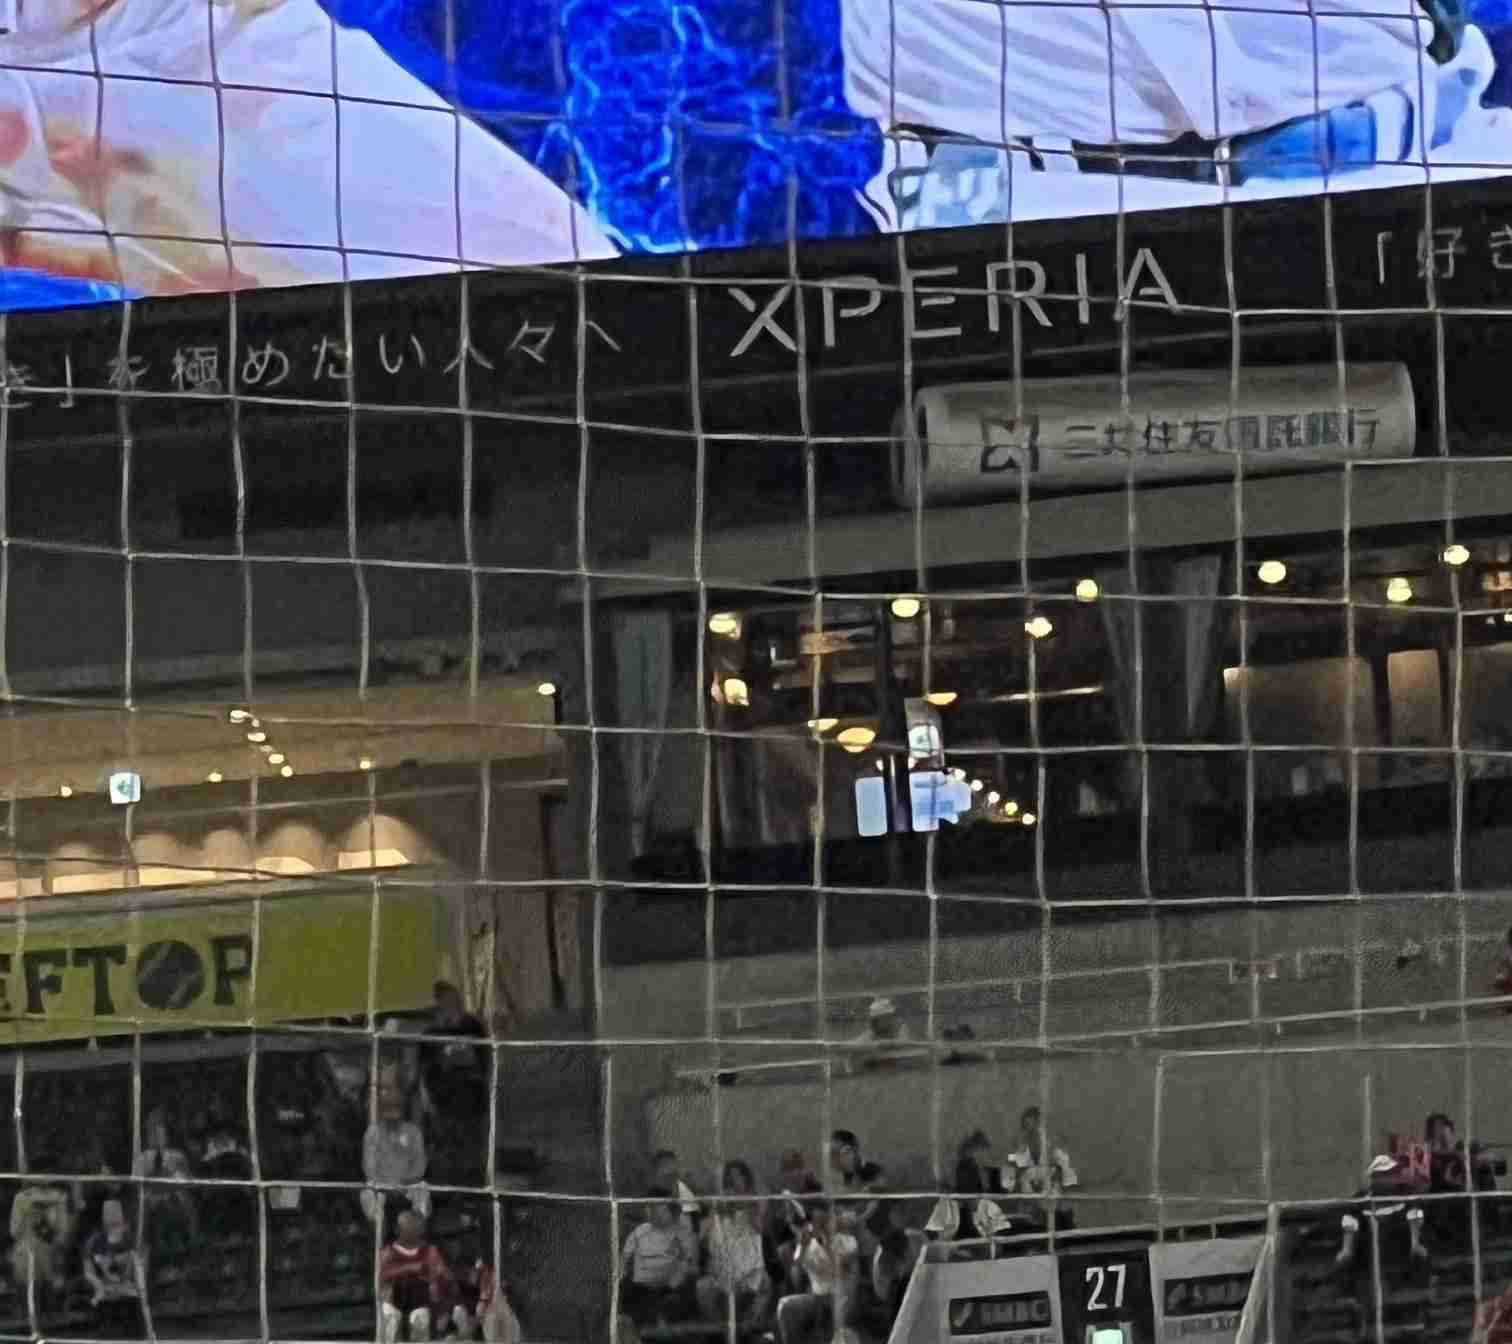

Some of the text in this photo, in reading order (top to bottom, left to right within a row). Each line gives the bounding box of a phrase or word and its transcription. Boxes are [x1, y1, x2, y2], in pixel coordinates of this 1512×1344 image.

[728, 247, 1180, 358] XPERIA
[0, 934, 254, 1016] FTOP
[1085, 1263, 1127, 1311] 27
